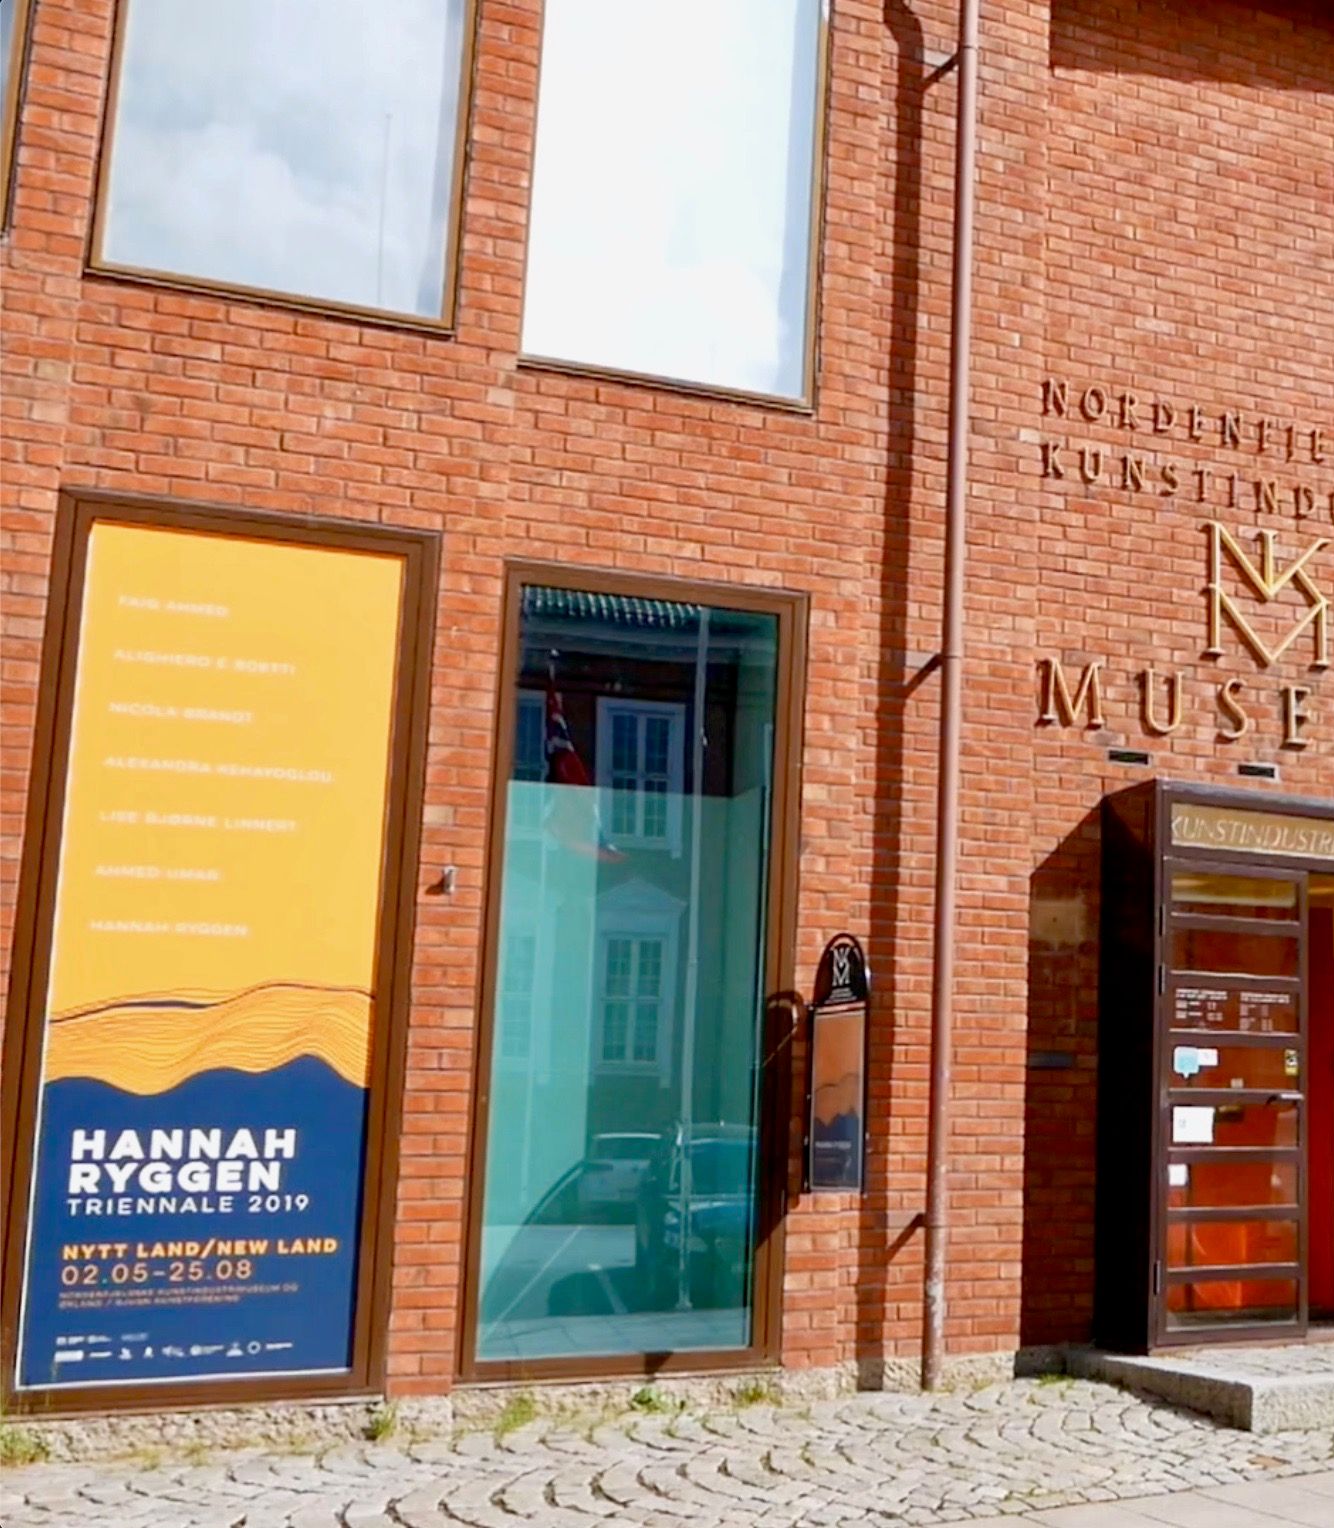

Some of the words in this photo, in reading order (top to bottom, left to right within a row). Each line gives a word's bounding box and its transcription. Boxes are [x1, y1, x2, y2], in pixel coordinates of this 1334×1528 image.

[108, 702, 177, 718] NICOLA
[103, 757, 211, 774] ALEXANDRA
[95, 865, 160, 880] AHMED
[89, 919, 169, 933] HANNAH
[174, 923, 250, 938] RYGGEN
[70, 1128, 297, 1161] HANNAH
[67, 1161, 282, 1195] RYGGEN
[67, 1196, 234, 1216] TRIENNALE
[248, 1194, 310, 1213] 2019
[62, 1243, 128, 1261] NYTT
[135, 1238, 269, 1261] LAND/NEW
[276, 1237, 339, 1255] LAND
[61, 1259, 254, 1286] 02.05-25.08
